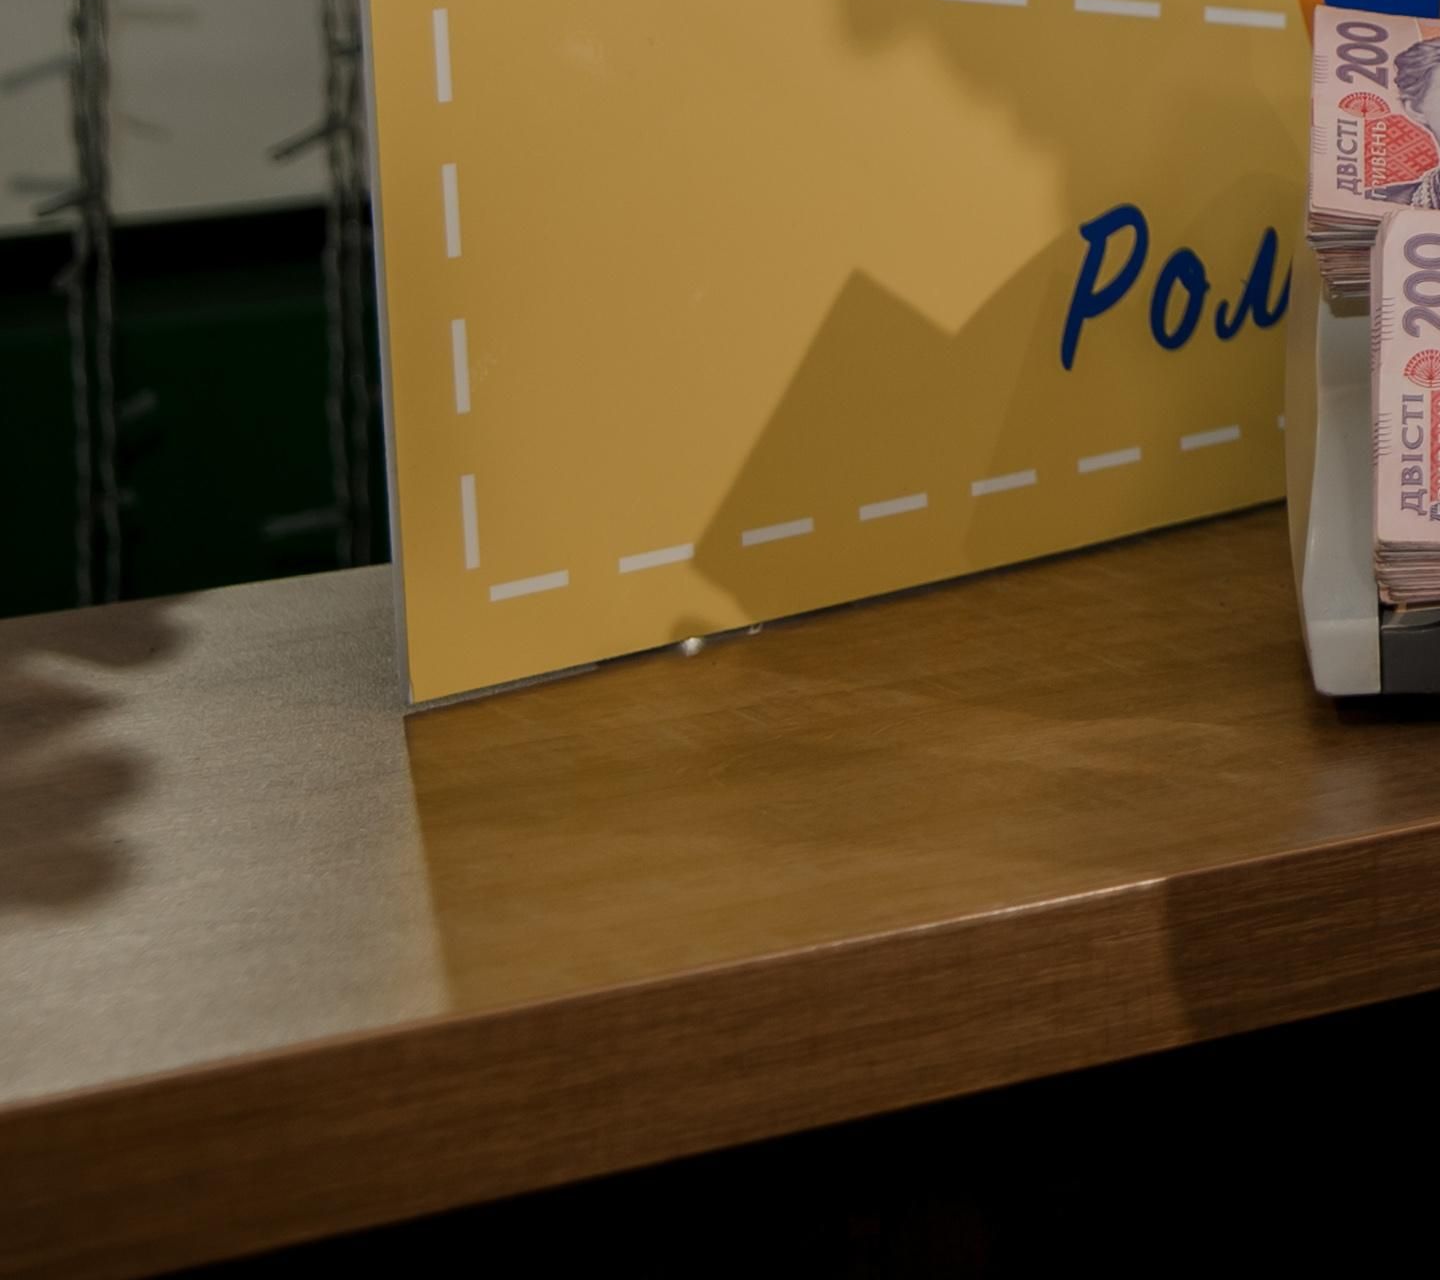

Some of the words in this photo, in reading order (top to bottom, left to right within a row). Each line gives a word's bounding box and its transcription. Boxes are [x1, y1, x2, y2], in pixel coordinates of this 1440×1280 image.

[1335, 21, 1390, 90] 200
[1337, 118, 1363, 196] ДВІСТІ
[1401, 393, 1428, 516] ДВІСТІ
